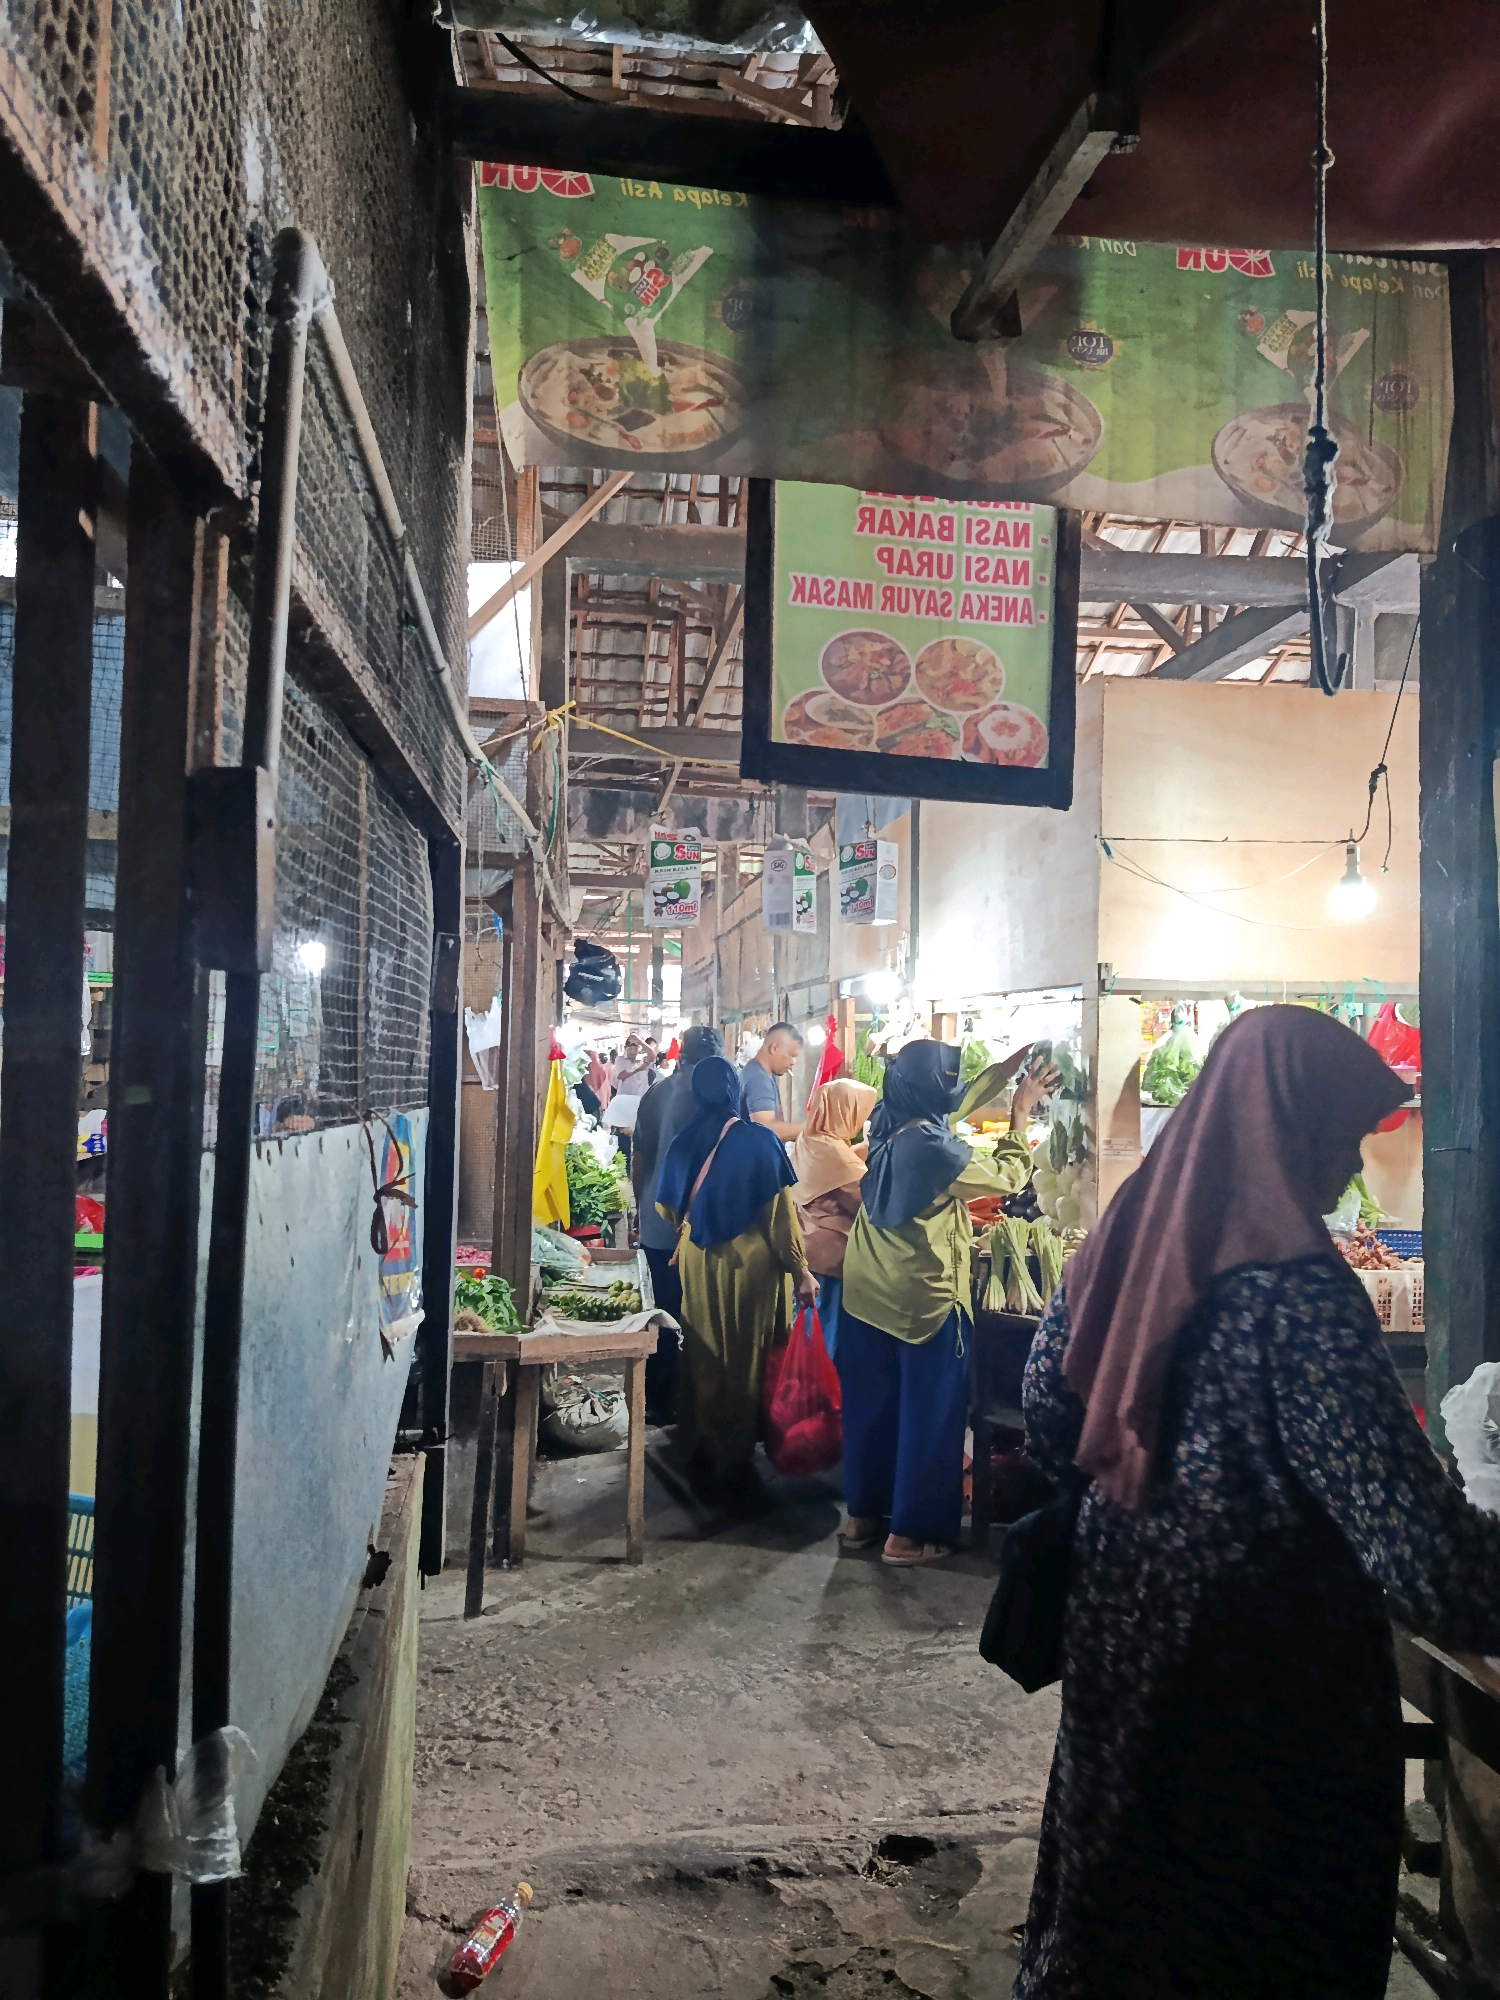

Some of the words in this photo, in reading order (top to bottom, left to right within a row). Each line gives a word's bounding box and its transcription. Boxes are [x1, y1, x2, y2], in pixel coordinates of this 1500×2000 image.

[674, 844, 700, 861] SUN
[855, 844, 875, 859] SUN
[666, 901, 698, 915] 110ml
